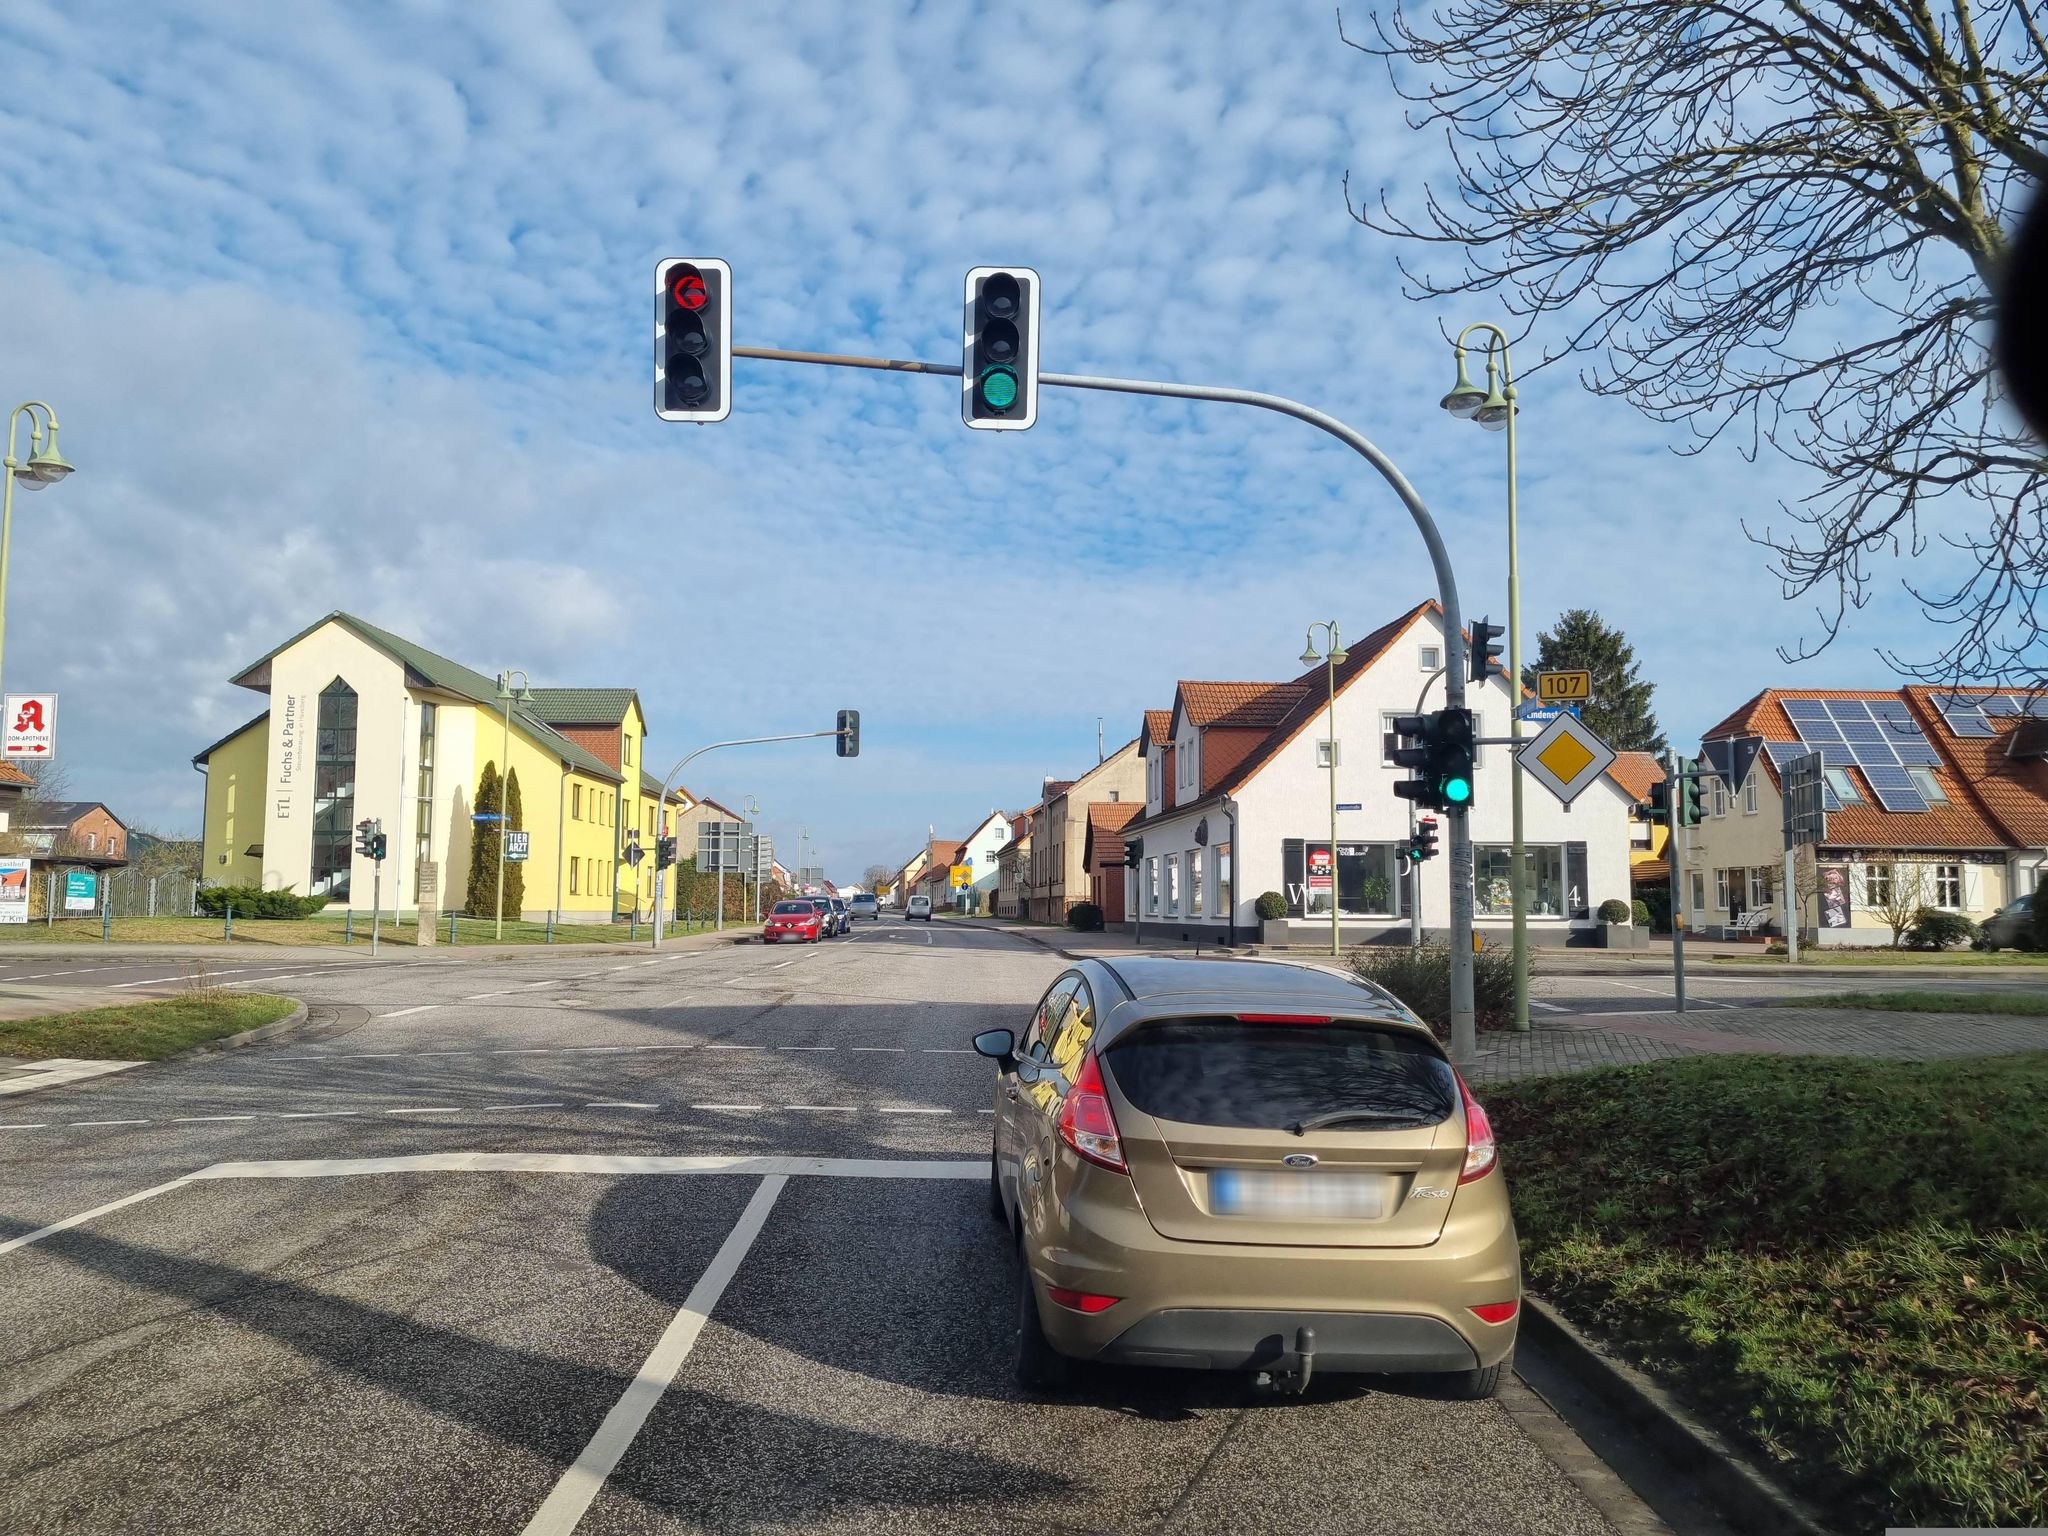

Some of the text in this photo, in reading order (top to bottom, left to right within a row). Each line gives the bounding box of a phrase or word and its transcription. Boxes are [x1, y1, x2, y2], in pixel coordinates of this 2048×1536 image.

[1547, 676, 1581, 695] 107
[280, 694, 305, 783] Fuchs & Partner
[277, 796, 291, 819] ETL
[508, 833, 528, 843] TIER
[508, 842, 528, 852] ARZT
[1897, 853, 1961, 863] BARBERSHOP
[1409, 1186, 1450, 1200] Fiesta
